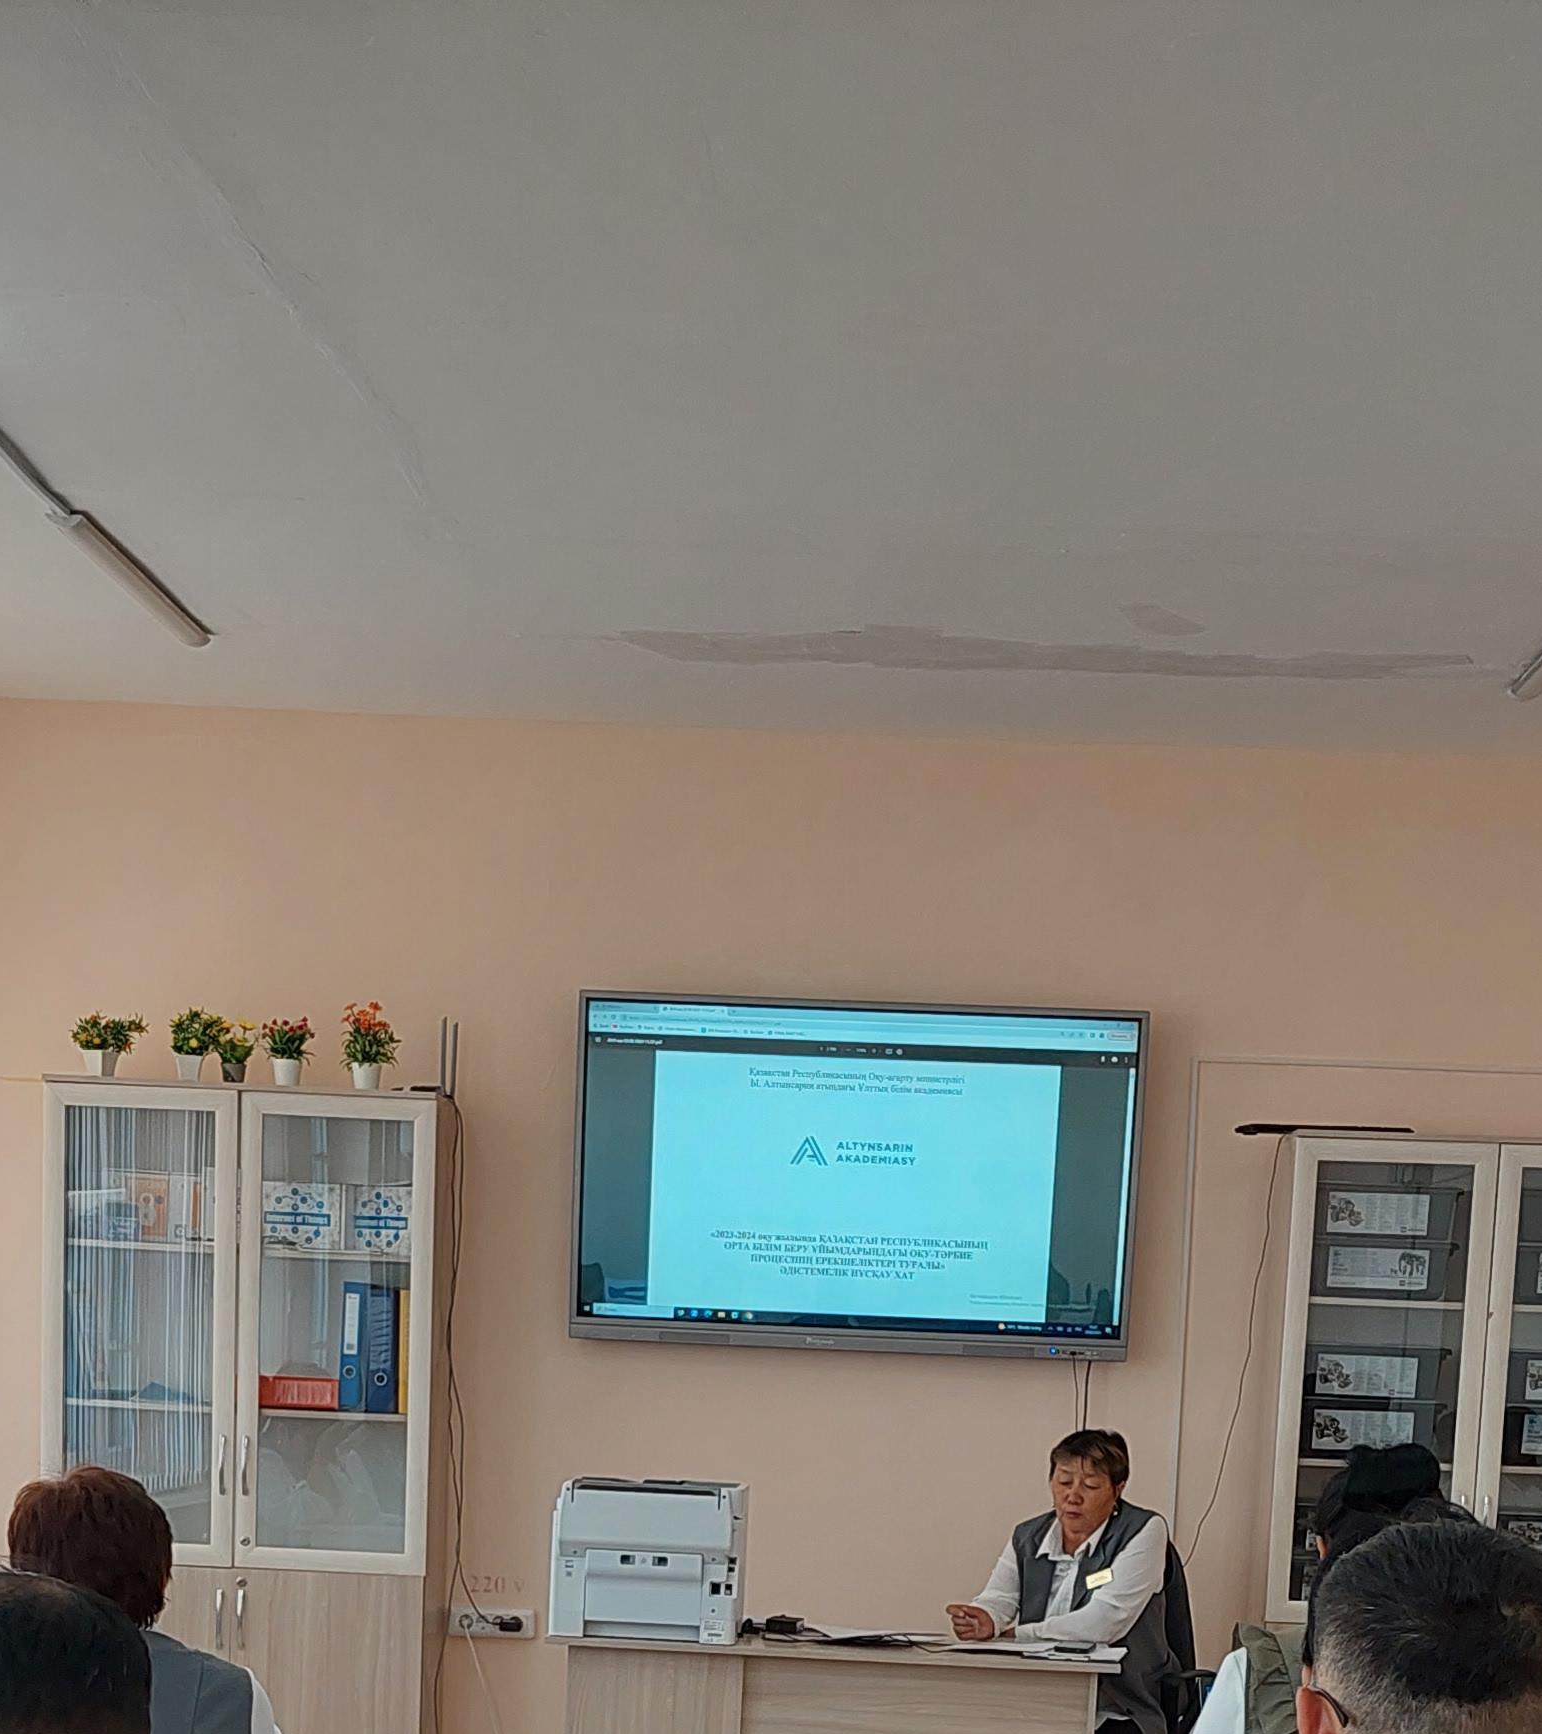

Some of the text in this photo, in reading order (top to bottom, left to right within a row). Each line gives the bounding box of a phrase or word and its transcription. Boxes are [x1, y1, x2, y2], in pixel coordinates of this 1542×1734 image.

[836, 1141, 914, 1153] ALTYNSARIN
[836, 1154, 916, 1166] AKADEMIASY
[723, 1241, 750, 1251] ОРТА
[752, 1242, 781, 1252] БІЛІМ
[784, 1243, 809, 1253] БЕРУ
[819, 1234, 878, 1244] ҚАЗАҚСТАН
[881, 1237, 988, 1250] РЕСПУБЛИКАСЫНЫҢ
[894, 1271, 915, 1280] ХАТ
